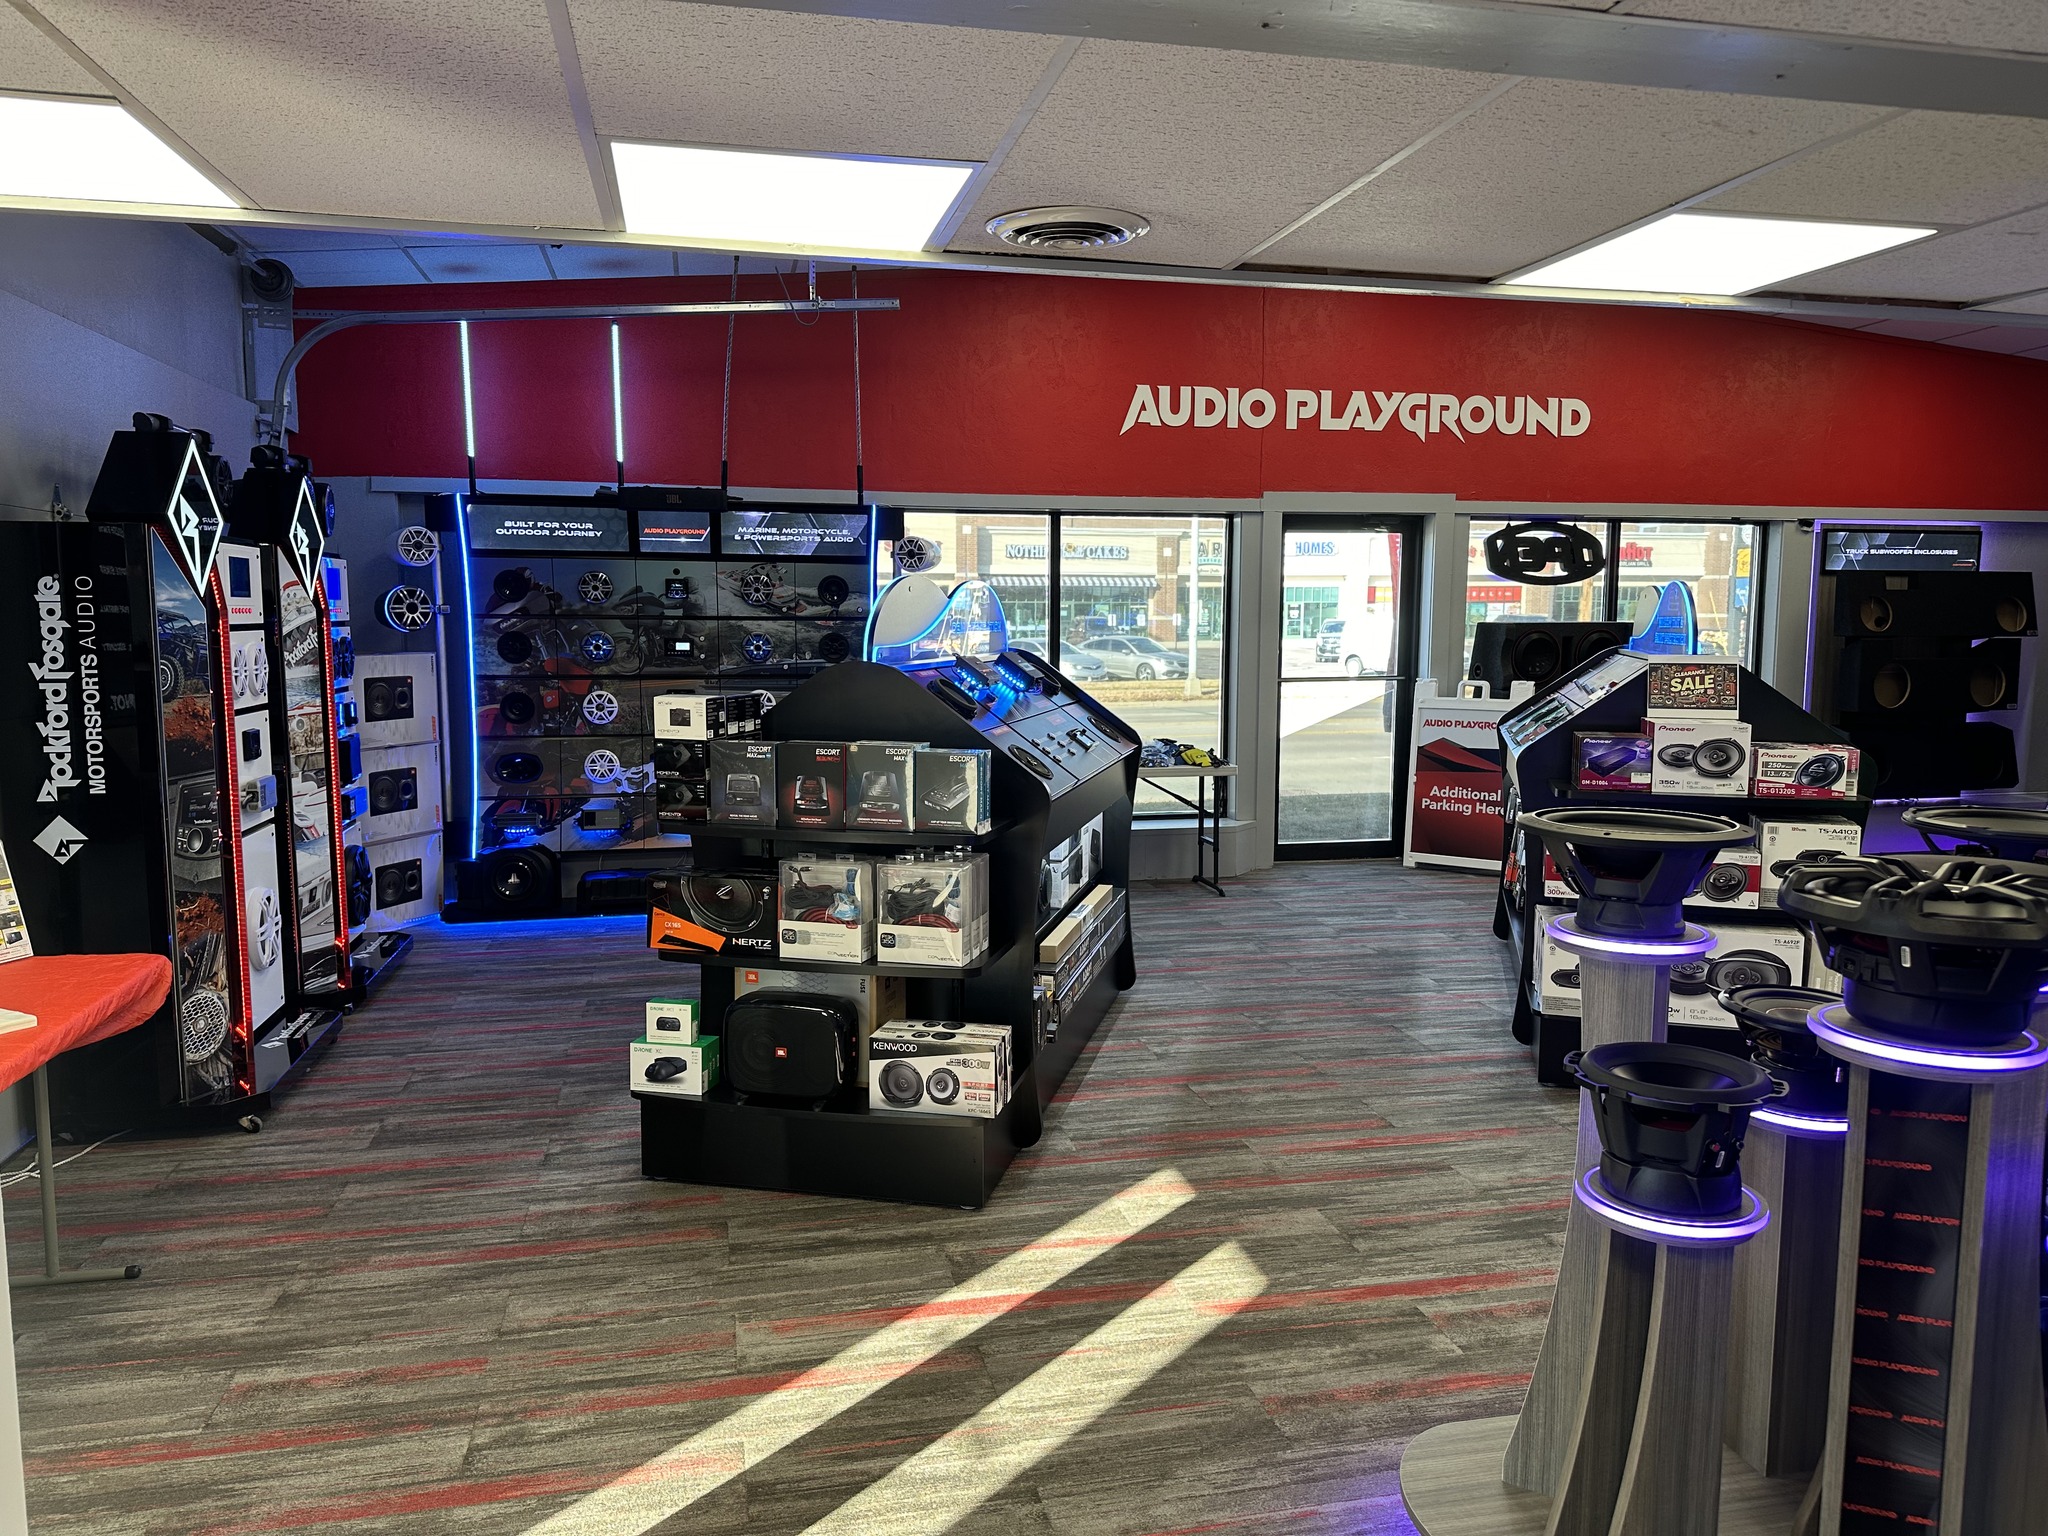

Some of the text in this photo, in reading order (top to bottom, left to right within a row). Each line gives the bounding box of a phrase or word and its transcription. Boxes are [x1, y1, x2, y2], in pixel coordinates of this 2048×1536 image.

[1119, 384, 1592, 444] AUDIO PLAYGROUND
[504, 520, 593, 530] BUILT FOR YOUR
[495, 528, 550, 536] OUTDOOR
[782, 527, 851, 536] MOTORCYCLE,
[1085, 546, 1129, 560] CAKES
[1674, 669, 1706, 678] CLEARANCE
[74, 575, 106, 794] MOTORSPORTS AUDIO
[1670, 674, 1715, 692] SALE
[1422, 719, 1453, 728] AUDIO
[35, 682, 82, 802] Rockford
[815, 748, 840, 756] ESCORT
[1430, 785, 1502, 802] Additional
[1421, 798, 1472, 815] Parking
[1818, 827, 1858, 836] TS-A4103
[732, 937, 772, 947] HERTZ
[873, 1041, 918, 1052] KENWOOD
[1890, 1109, 1917, 1118] AUDIO
[1893, 1212, 1921, 1221] AUDIO
[1875, 1260, 1936, 1274] PLAYGROUND
[1897, 1314, 1926, 1324] AUDIO
[1879, 1360, 1940, 1376] PLAYGROUND
[1901, 1414, 1930, 1425] AUDIO
[1856, 1456, 1884, 1467] AUDIO
